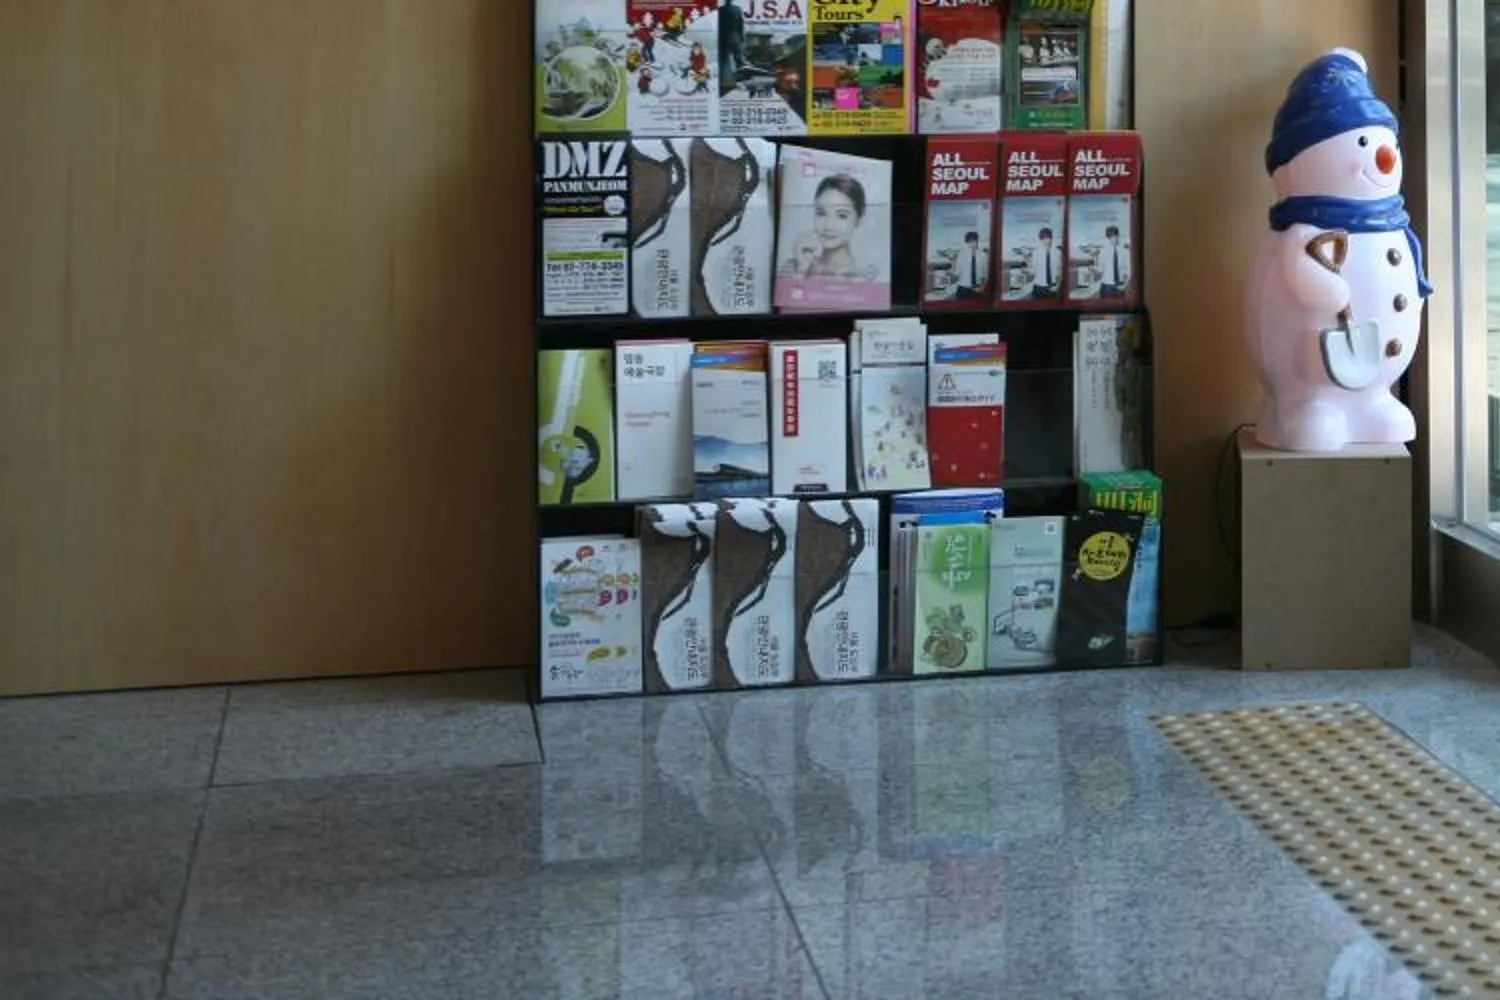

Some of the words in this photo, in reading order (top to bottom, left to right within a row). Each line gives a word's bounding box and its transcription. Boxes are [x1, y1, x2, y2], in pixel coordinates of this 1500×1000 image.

[814, 6, 865, 21] Tours
[543, 141, 628, 179] DMZ
[933, 153, 964, 167] ALL
[1008, 151, 1040, 164] ALL
[1075, 149, 1106, 163] ALL
[931, 167, 989, 181] SEOUL
[1007, 165, 1064, 178] SEOUL
[1073, 163, 1130, 177] SEOUL
[931, 182, 970, 195] MAP
[1006, 178, 1043, 192] MAP
[1072, 177, 1109, 190] MAP
